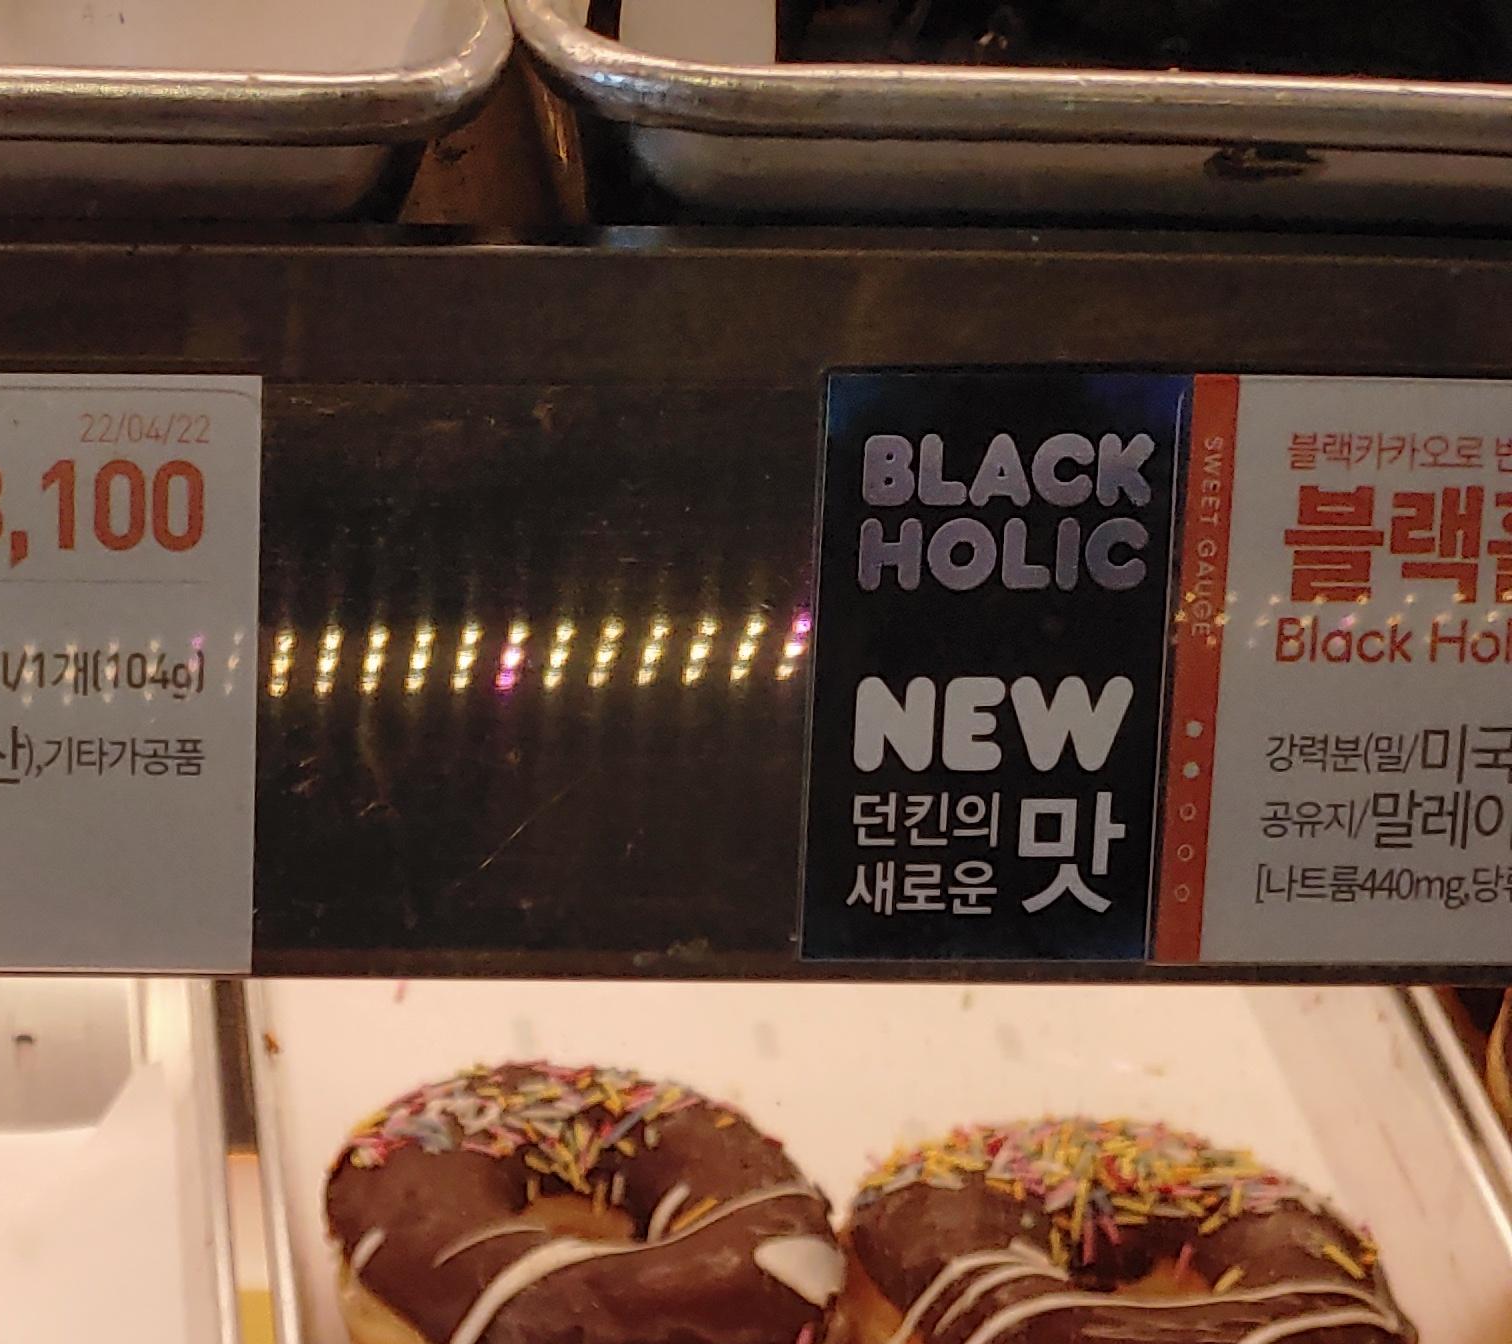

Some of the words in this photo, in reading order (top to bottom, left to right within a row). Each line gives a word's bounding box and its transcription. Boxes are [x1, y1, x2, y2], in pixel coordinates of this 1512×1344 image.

[78, 412, 211, 445] 22/04/22
[1286, 431, 1485, 472] 블랙카카오로
[862, 433, 1156, 507] BLACK
[1200, 436, 1225, 528] SWEET
[857, 517, 1149, 592] HOLIC
[1275, 614, 1413, 664] Black
[852, 675, 1135, 773] NEW
[852, 791, 1001, 848] 던킨의
[1017, 791, 1126, 914] 맛
[846, 859, 998, 916] 새로운
[1254, 863, 1512, 911] [나트륨440mg,당
